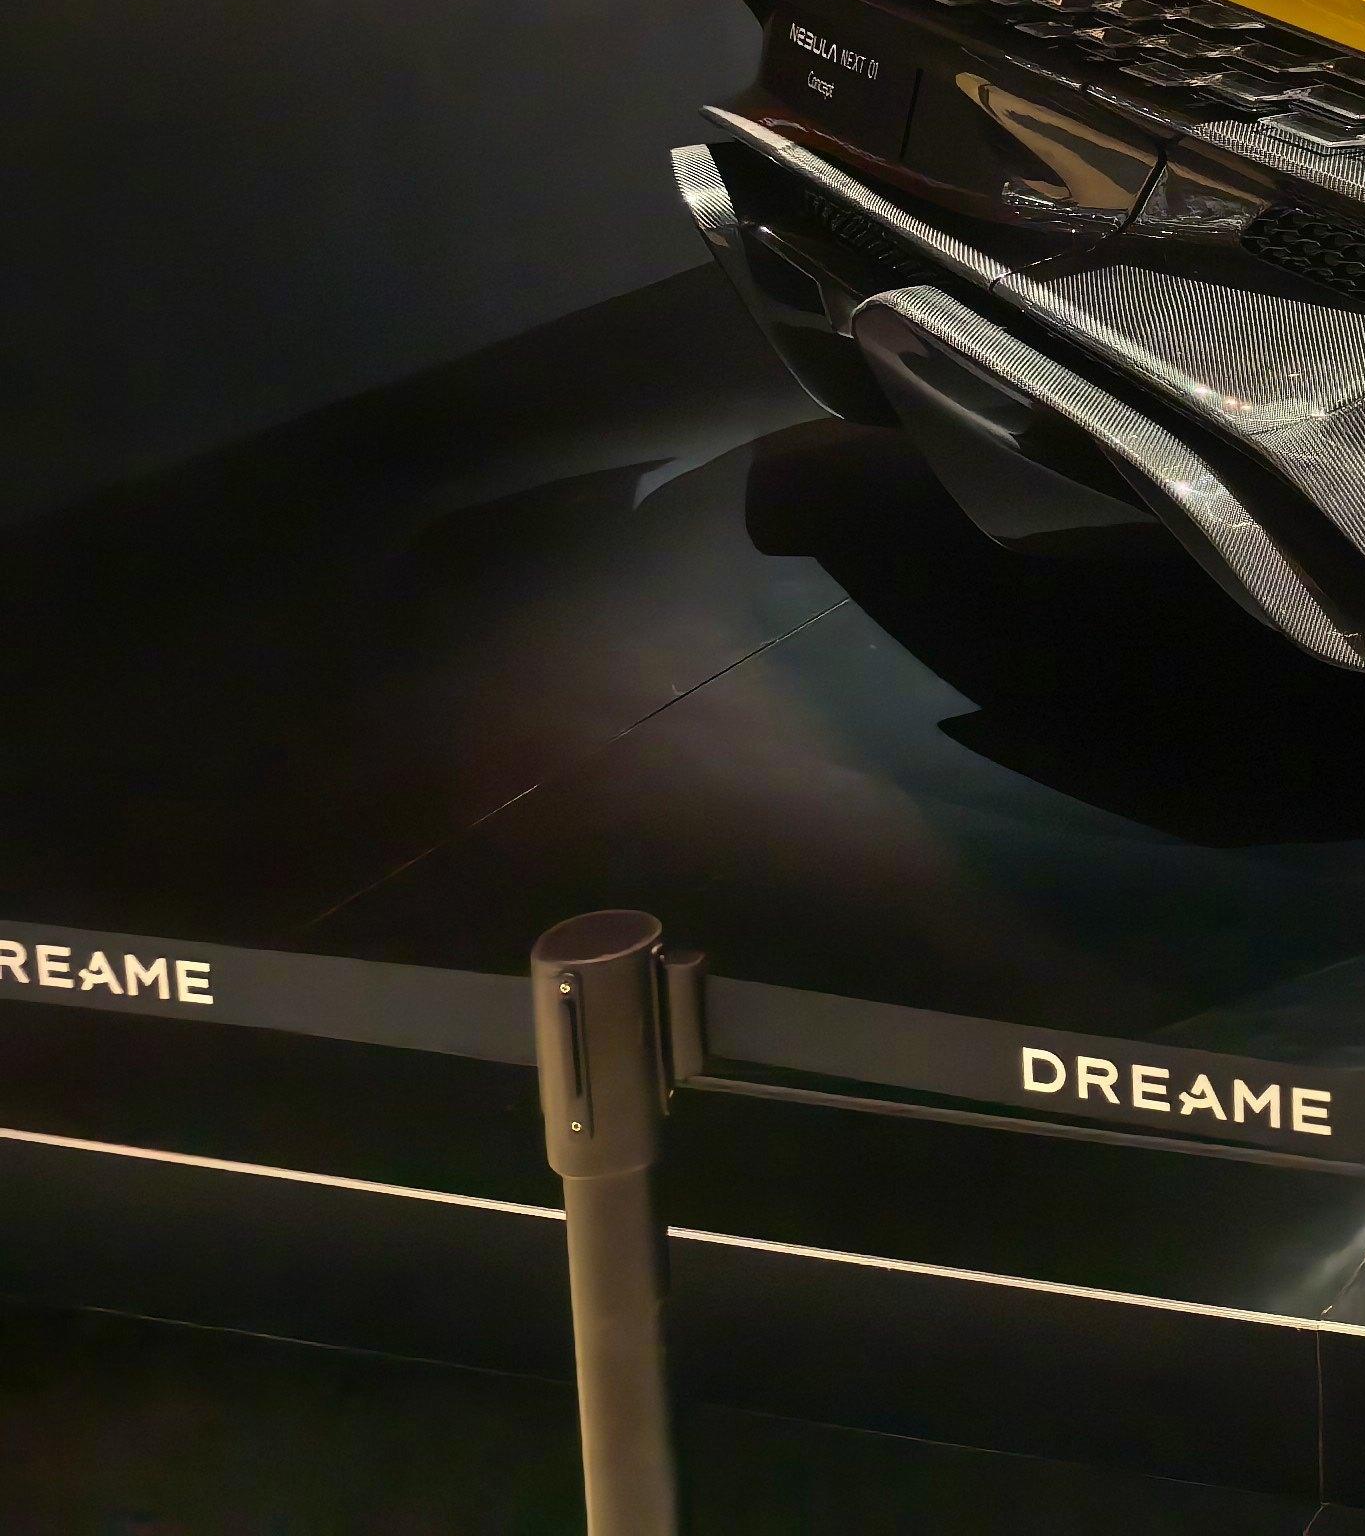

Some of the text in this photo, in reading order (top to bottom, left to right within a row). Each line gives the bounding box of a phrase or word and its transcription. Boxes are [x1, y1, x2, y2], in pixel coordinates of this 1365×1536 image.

[789, 22, 837, 63] NEBULA
[840, 49, 867, 74] NEXT
[1022, 1047, 1331, 1135] DREAME
